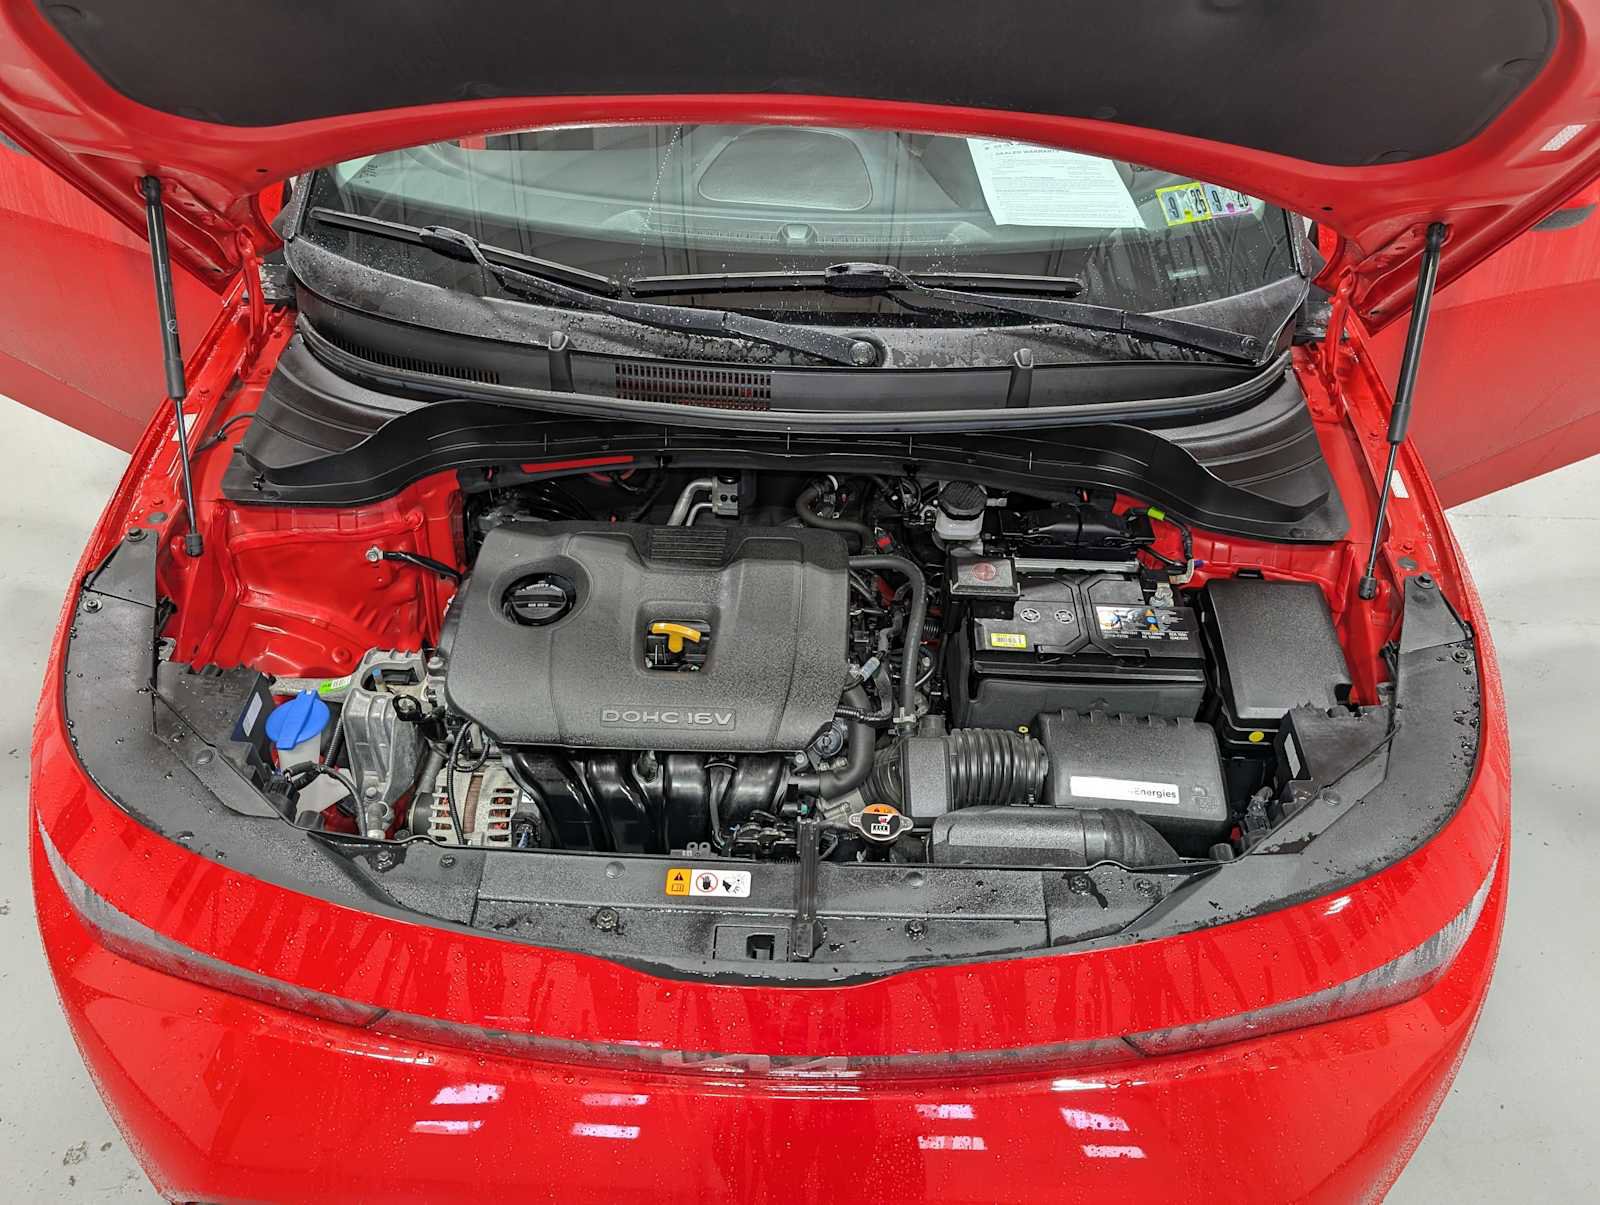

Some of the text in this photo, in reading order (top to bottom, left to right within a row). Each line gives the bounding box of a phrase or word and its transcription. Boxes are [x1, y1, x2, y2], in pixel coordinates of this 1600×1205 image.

[1168, 196, 1180, 218] 9
[1211, 190, 1223, 212] 9
[601, 709, 733, 726] DOHC 16V
